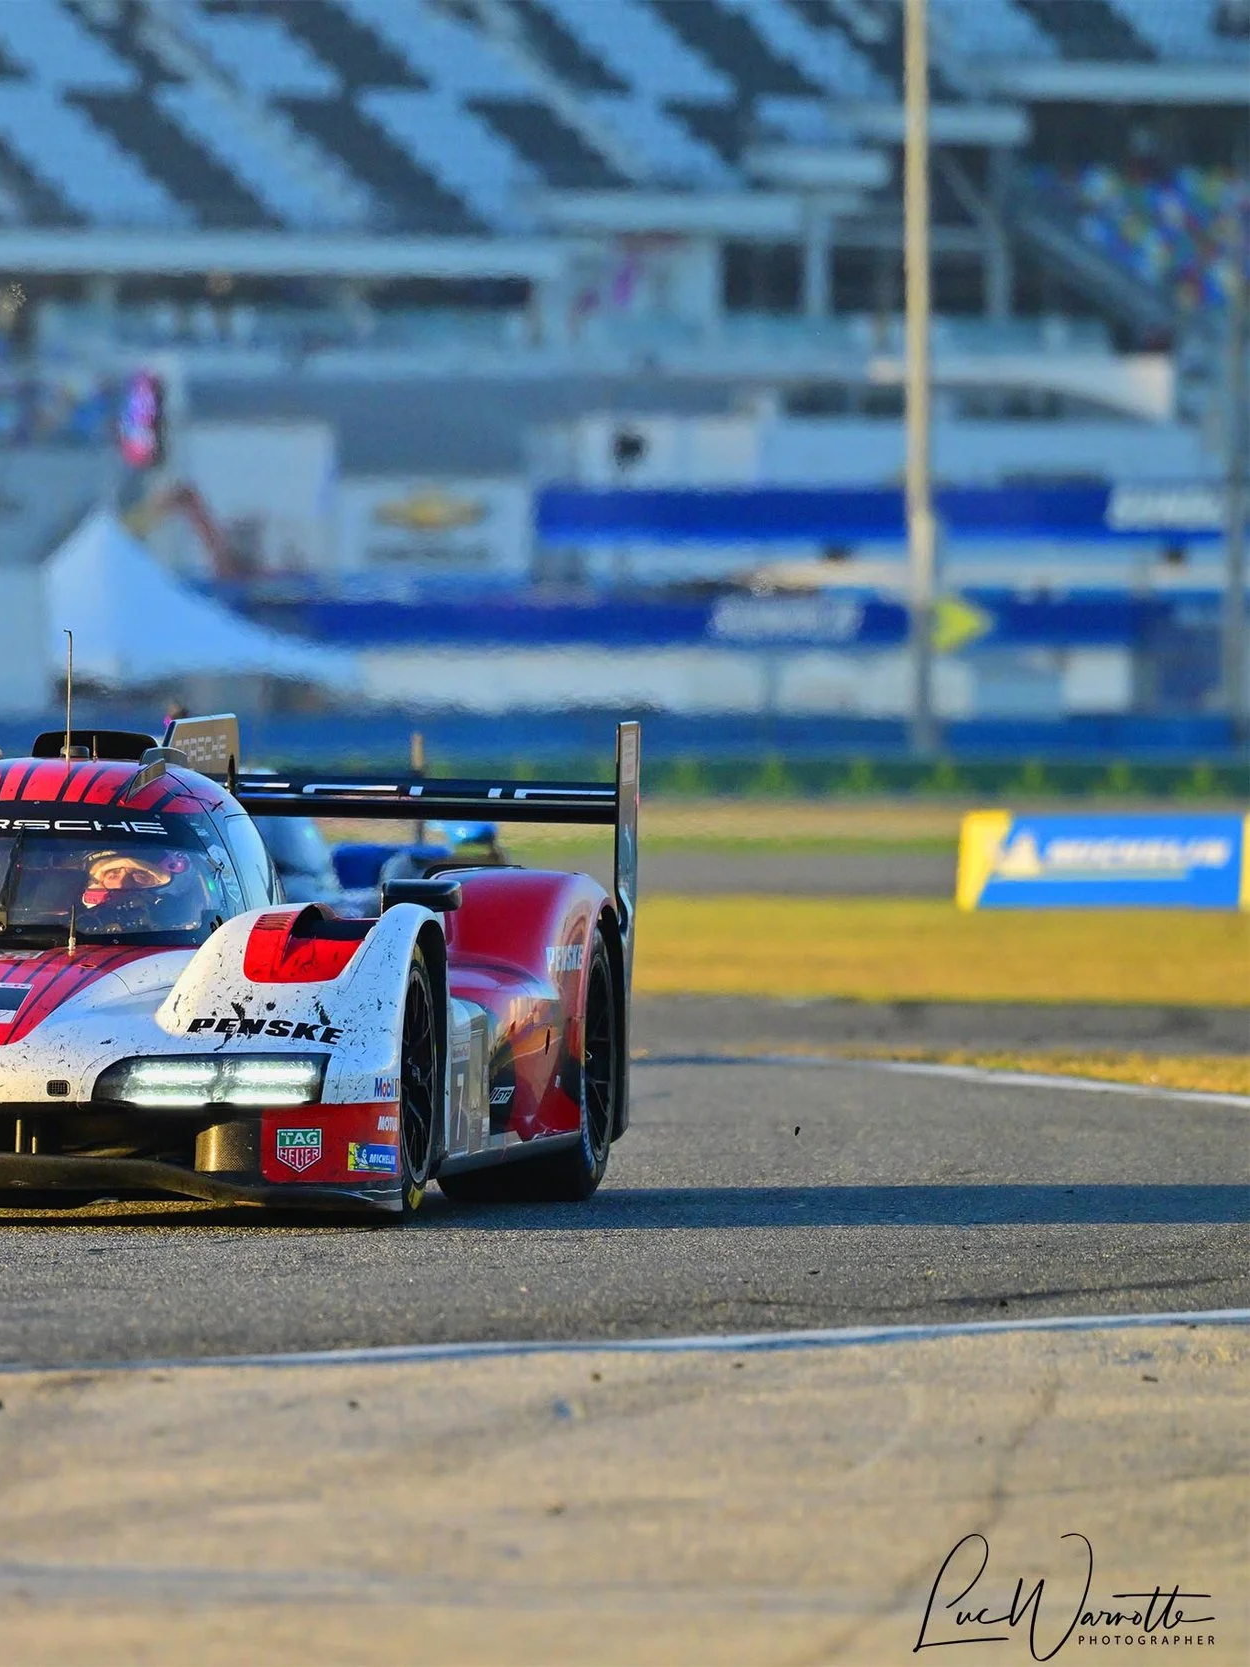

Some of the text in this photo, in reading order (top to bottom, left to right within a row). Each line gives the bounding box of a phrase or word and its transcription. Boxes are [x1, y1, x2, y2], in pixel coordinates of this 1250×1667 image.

[186, 1017, 345, 1046] PENSKE
[281, 1131, 318, 1145] TAG
[279, 1147, 319, 1169] HEUER
[369, 1153, 396, 1165] MICHELIN
